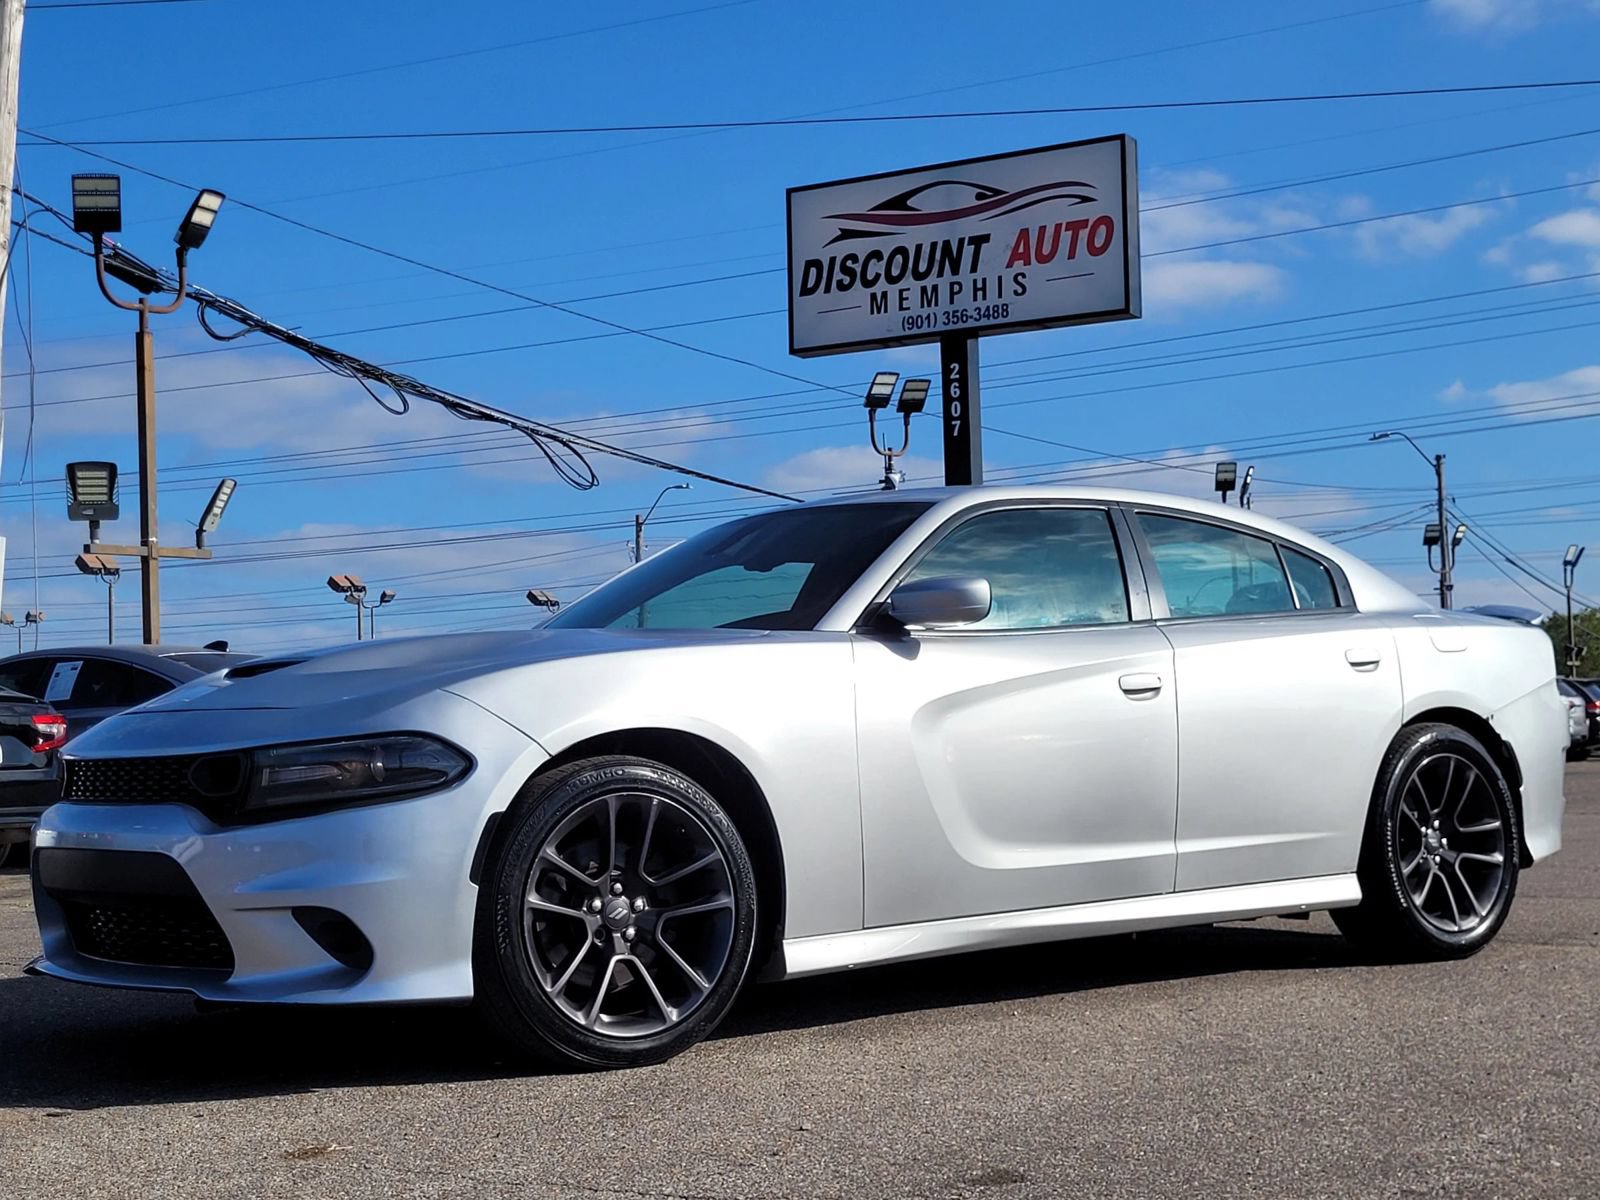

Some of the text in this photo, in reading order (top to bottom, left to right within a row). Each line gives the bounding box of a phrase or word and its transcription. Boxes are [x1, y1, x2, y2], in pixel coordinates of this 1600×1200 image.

[799, 215, 1115, 297] DISCOUNT AUTO
[869, 272, 1028, 315] MEMPHIS
[901, 303, 1010, 331] (901) 356-3488
[949, 362, 961, 437] 2607
